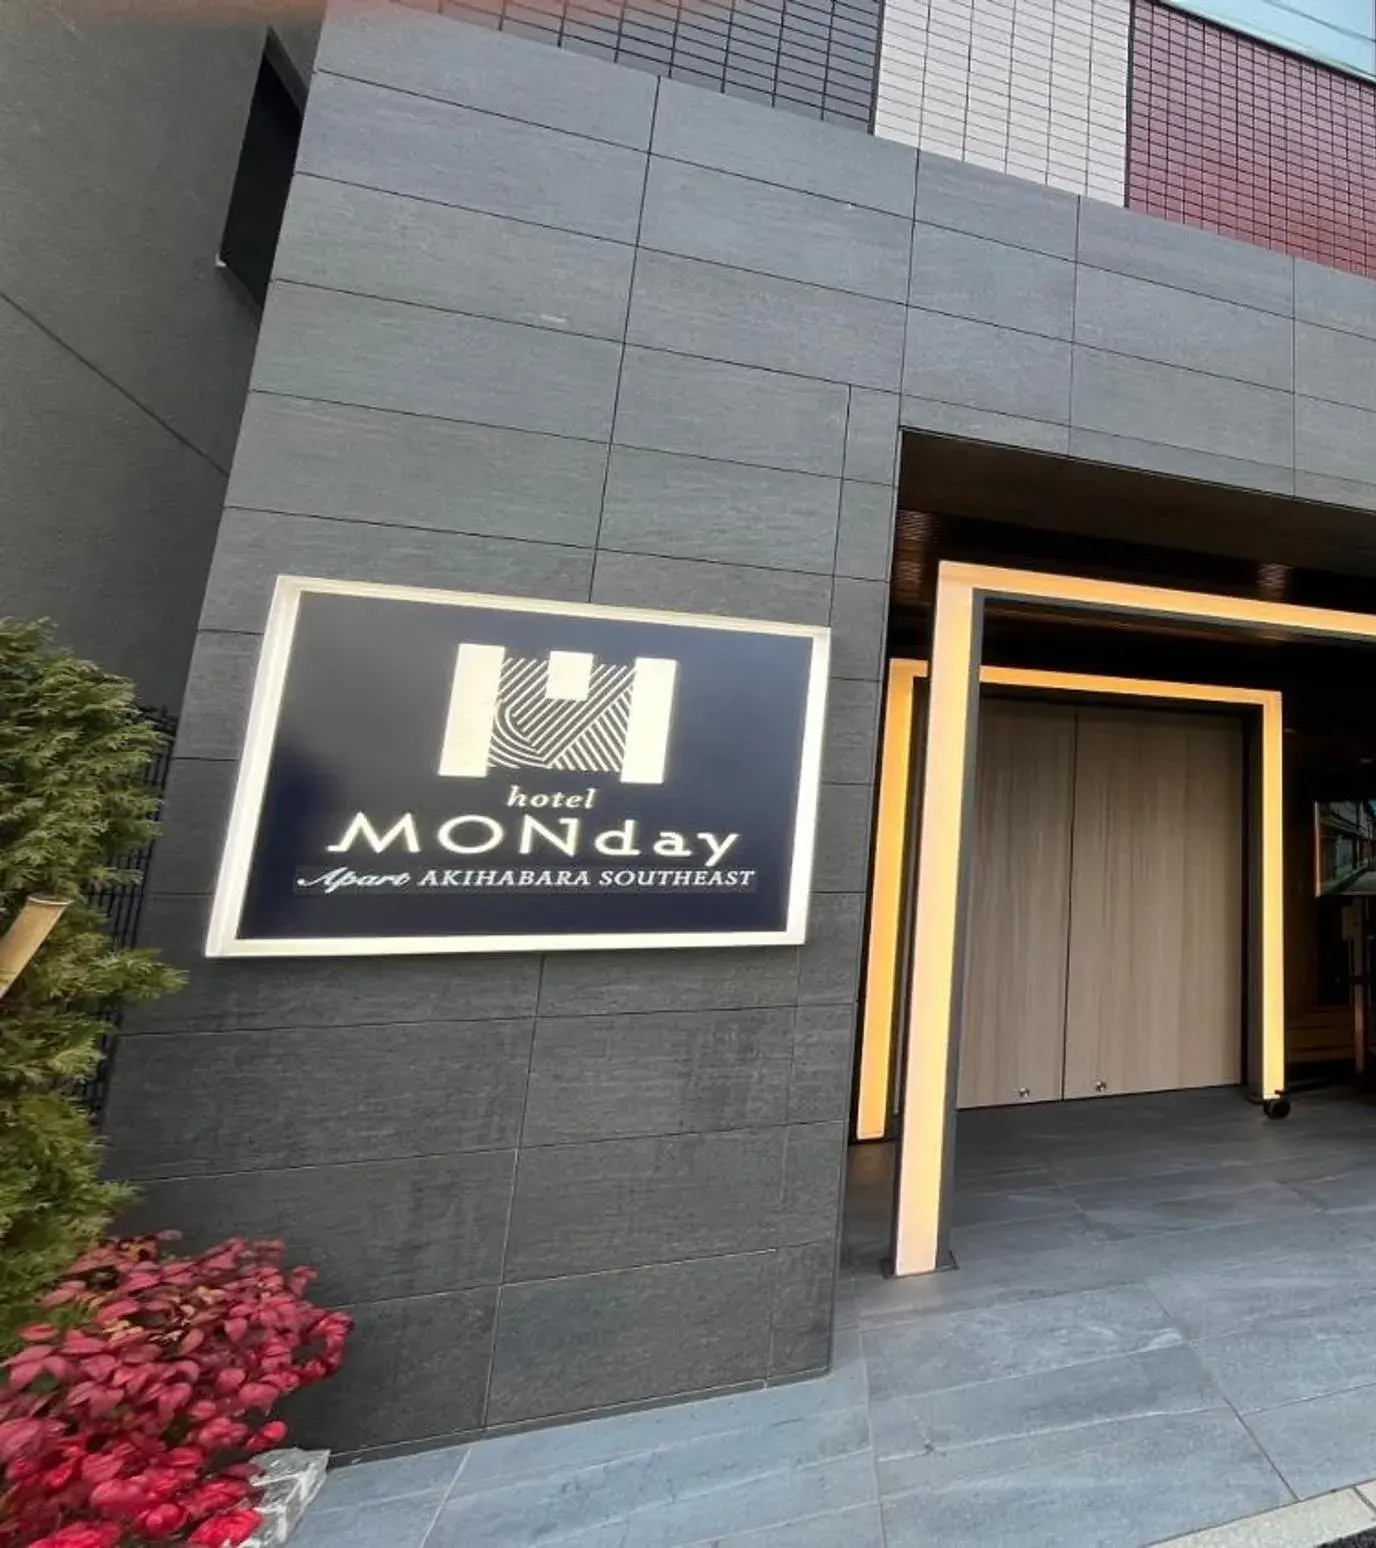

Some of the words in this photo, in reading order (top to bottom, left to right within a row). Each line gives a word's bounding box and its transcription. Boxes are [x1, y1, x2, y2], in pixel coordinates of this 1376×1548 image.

[507, 784, 597, 809] hotel
[327, 811, 741, 867] MONday
[297, 866, 411, 894] Apart
[417, 870, 591, 887] AKIHABARA
[598, 870, 755, 887] SOUTHEAST
